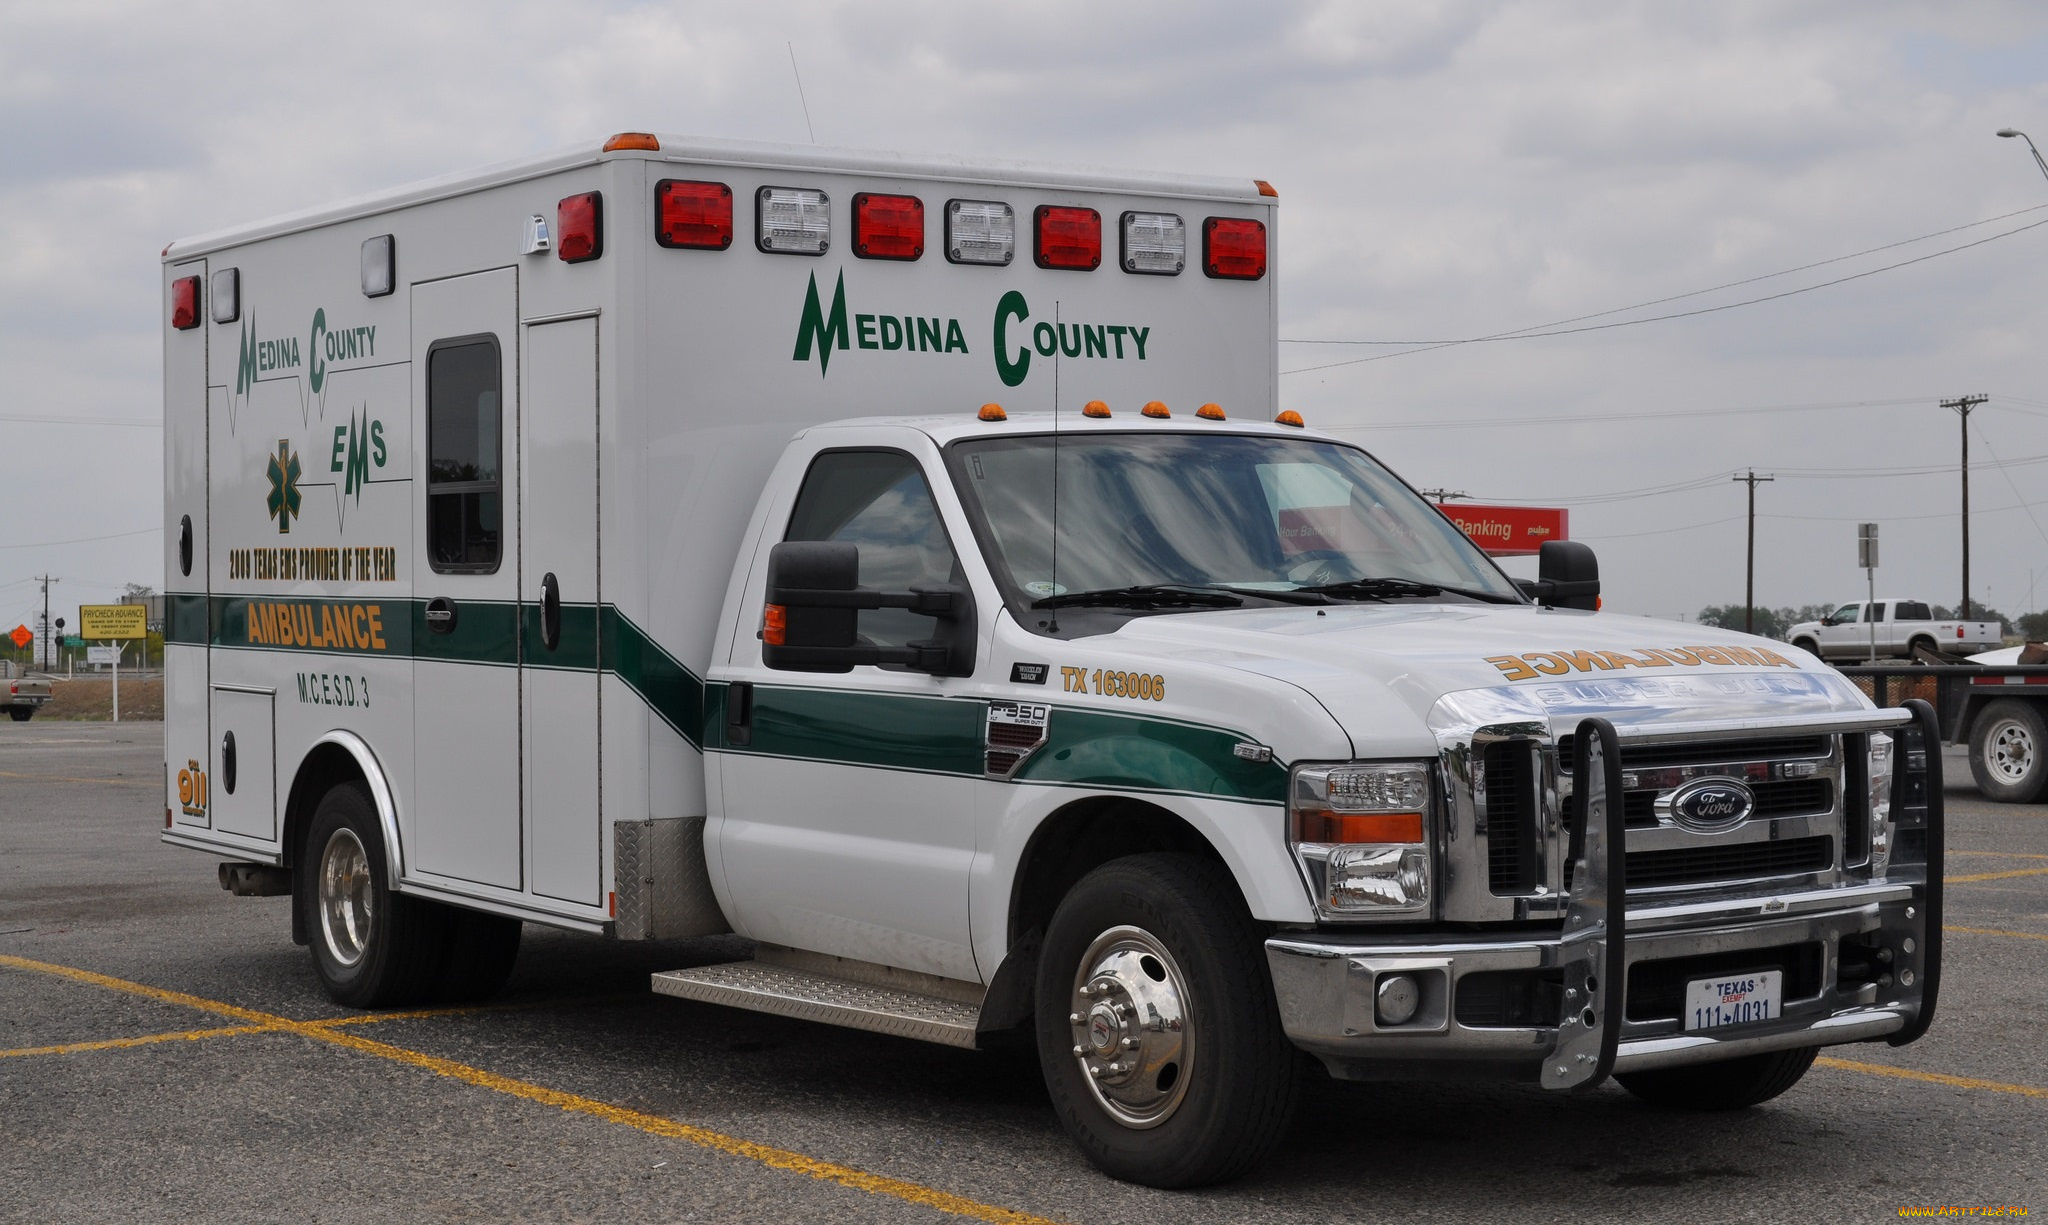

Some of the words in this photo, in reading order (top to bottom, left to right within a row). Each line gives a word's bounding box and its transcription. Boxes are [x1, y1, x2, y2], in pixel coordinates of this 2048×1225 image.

[792, 264, 969, 380] MEDINA
[993, 290, 1150, 387] COUNTY
[237, 306, 300, 408] MEDINA
[309, 307, 376, 394] COUNTY
[331, 400, 387, 510] EMS
[1454, 518, 1511, 540] Banking
[1528, 525, 1550, 536] pulse
[254, 548, 277, 580] TEXAS
[280, 548, 297, 580] EMS
[300, 548, 339, 581] PROVIDER
[342, 548, 352, 581] OF
[355, 547, 370, 581] THE
[373, 547, 395, 581] YEAR
[83, 608, 114, 618] PAYCHECK
[115, 608, 143, 618] ADVANCE
[248, 603, 386, 650] AMBULANCE
[297, 673, 359, 707] M.C.E.S.D.
[361, 677, 369, 708] 3
[1060, 666, 1088, 694] TX
[1092, 669, 1165, 701] 163006
[1535, 678, 1698, 705] SUPER
[1716, 675, 1809, 695] DUTY
[177, 768, 207, 808] 911
[1697, 792, 1735, 816] Ford
[1717, 979, 1755, 997] TEXAS
[1722, 993, 1746, 1003] EXEMPT
